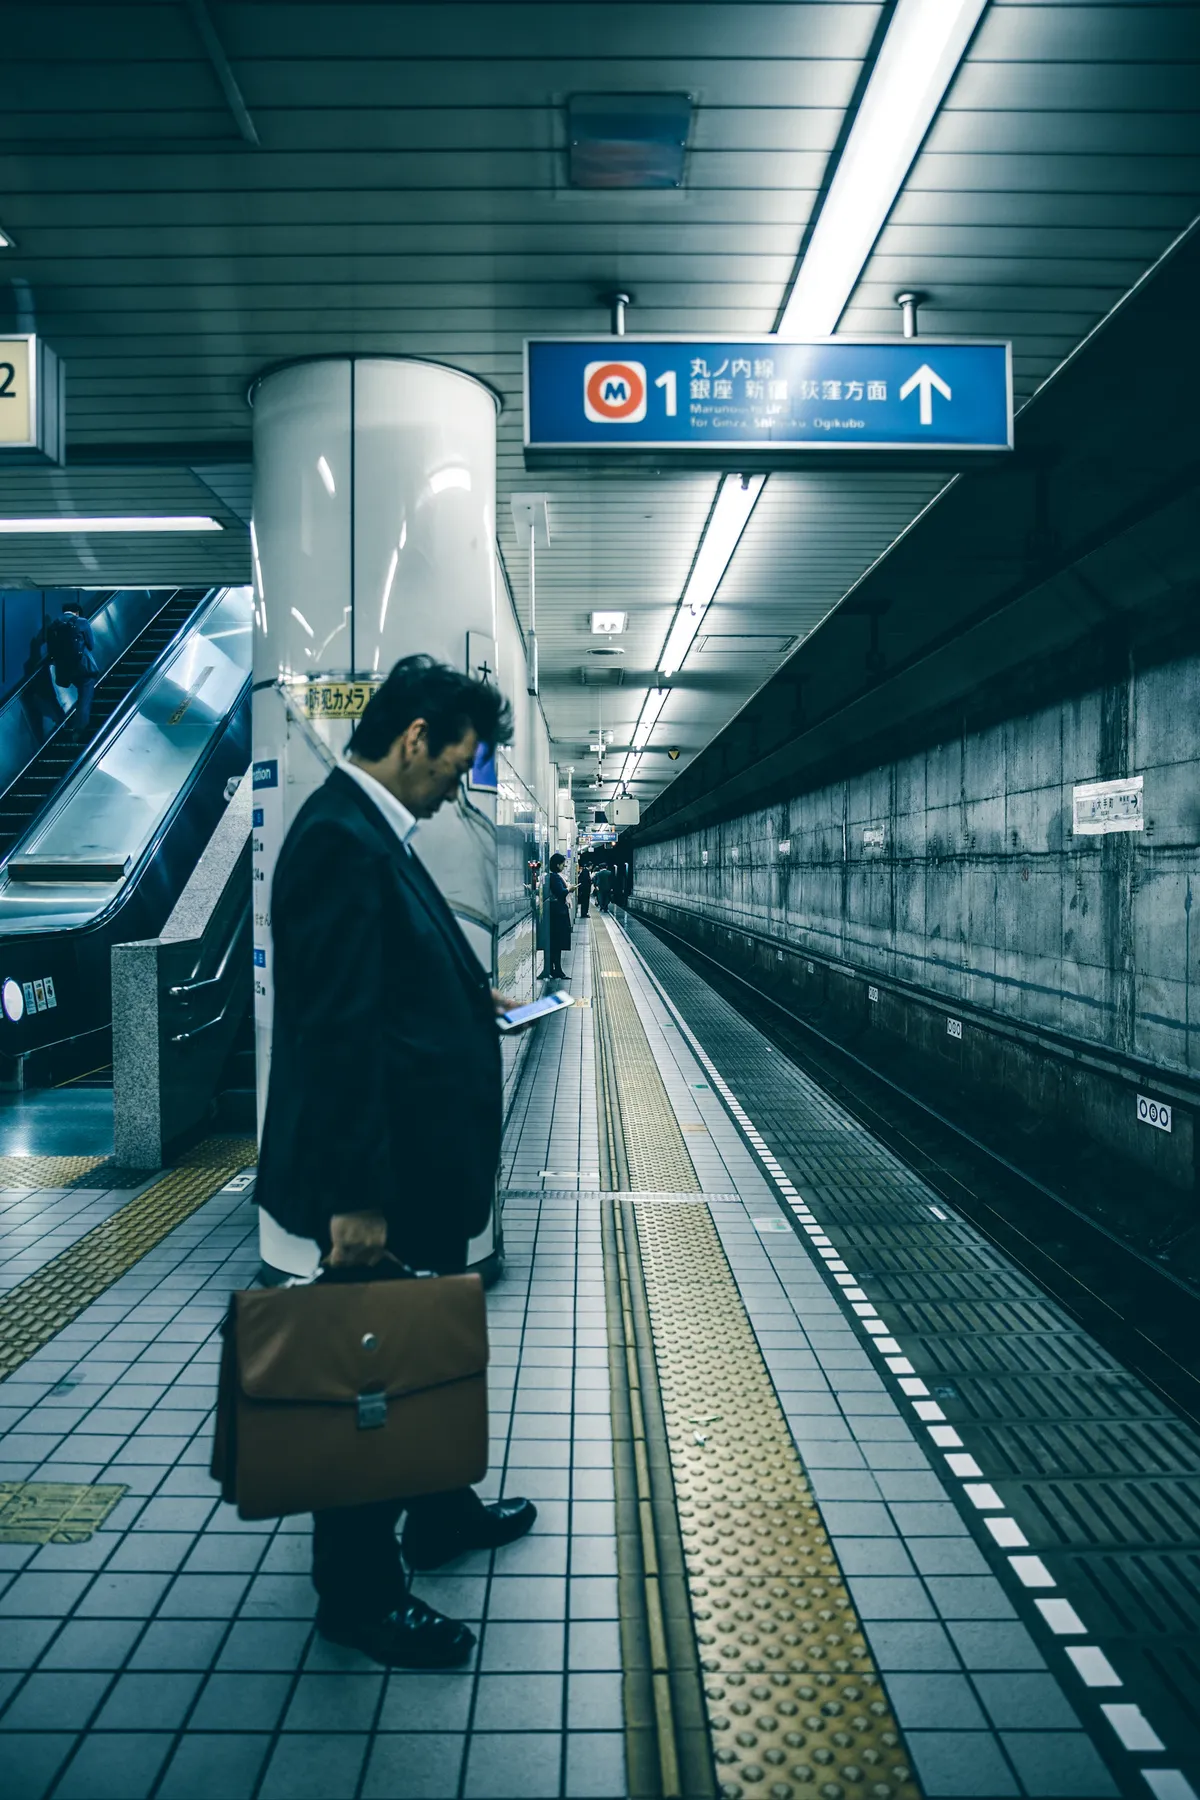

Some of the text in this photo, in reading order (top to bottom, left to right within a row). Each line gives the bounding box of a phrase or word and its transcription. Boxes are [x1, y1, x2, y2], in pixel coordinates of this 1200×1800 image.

[689, 357, 774, 379] 丸ノ内線
[0, 362, 16, 398] 2
[689, 379, 733, 400] 銀座
[654, 370, 678, 417] 1
[690, 403, 763, 414] Maruno
[813, 417, 866, 431] Ogikubo
